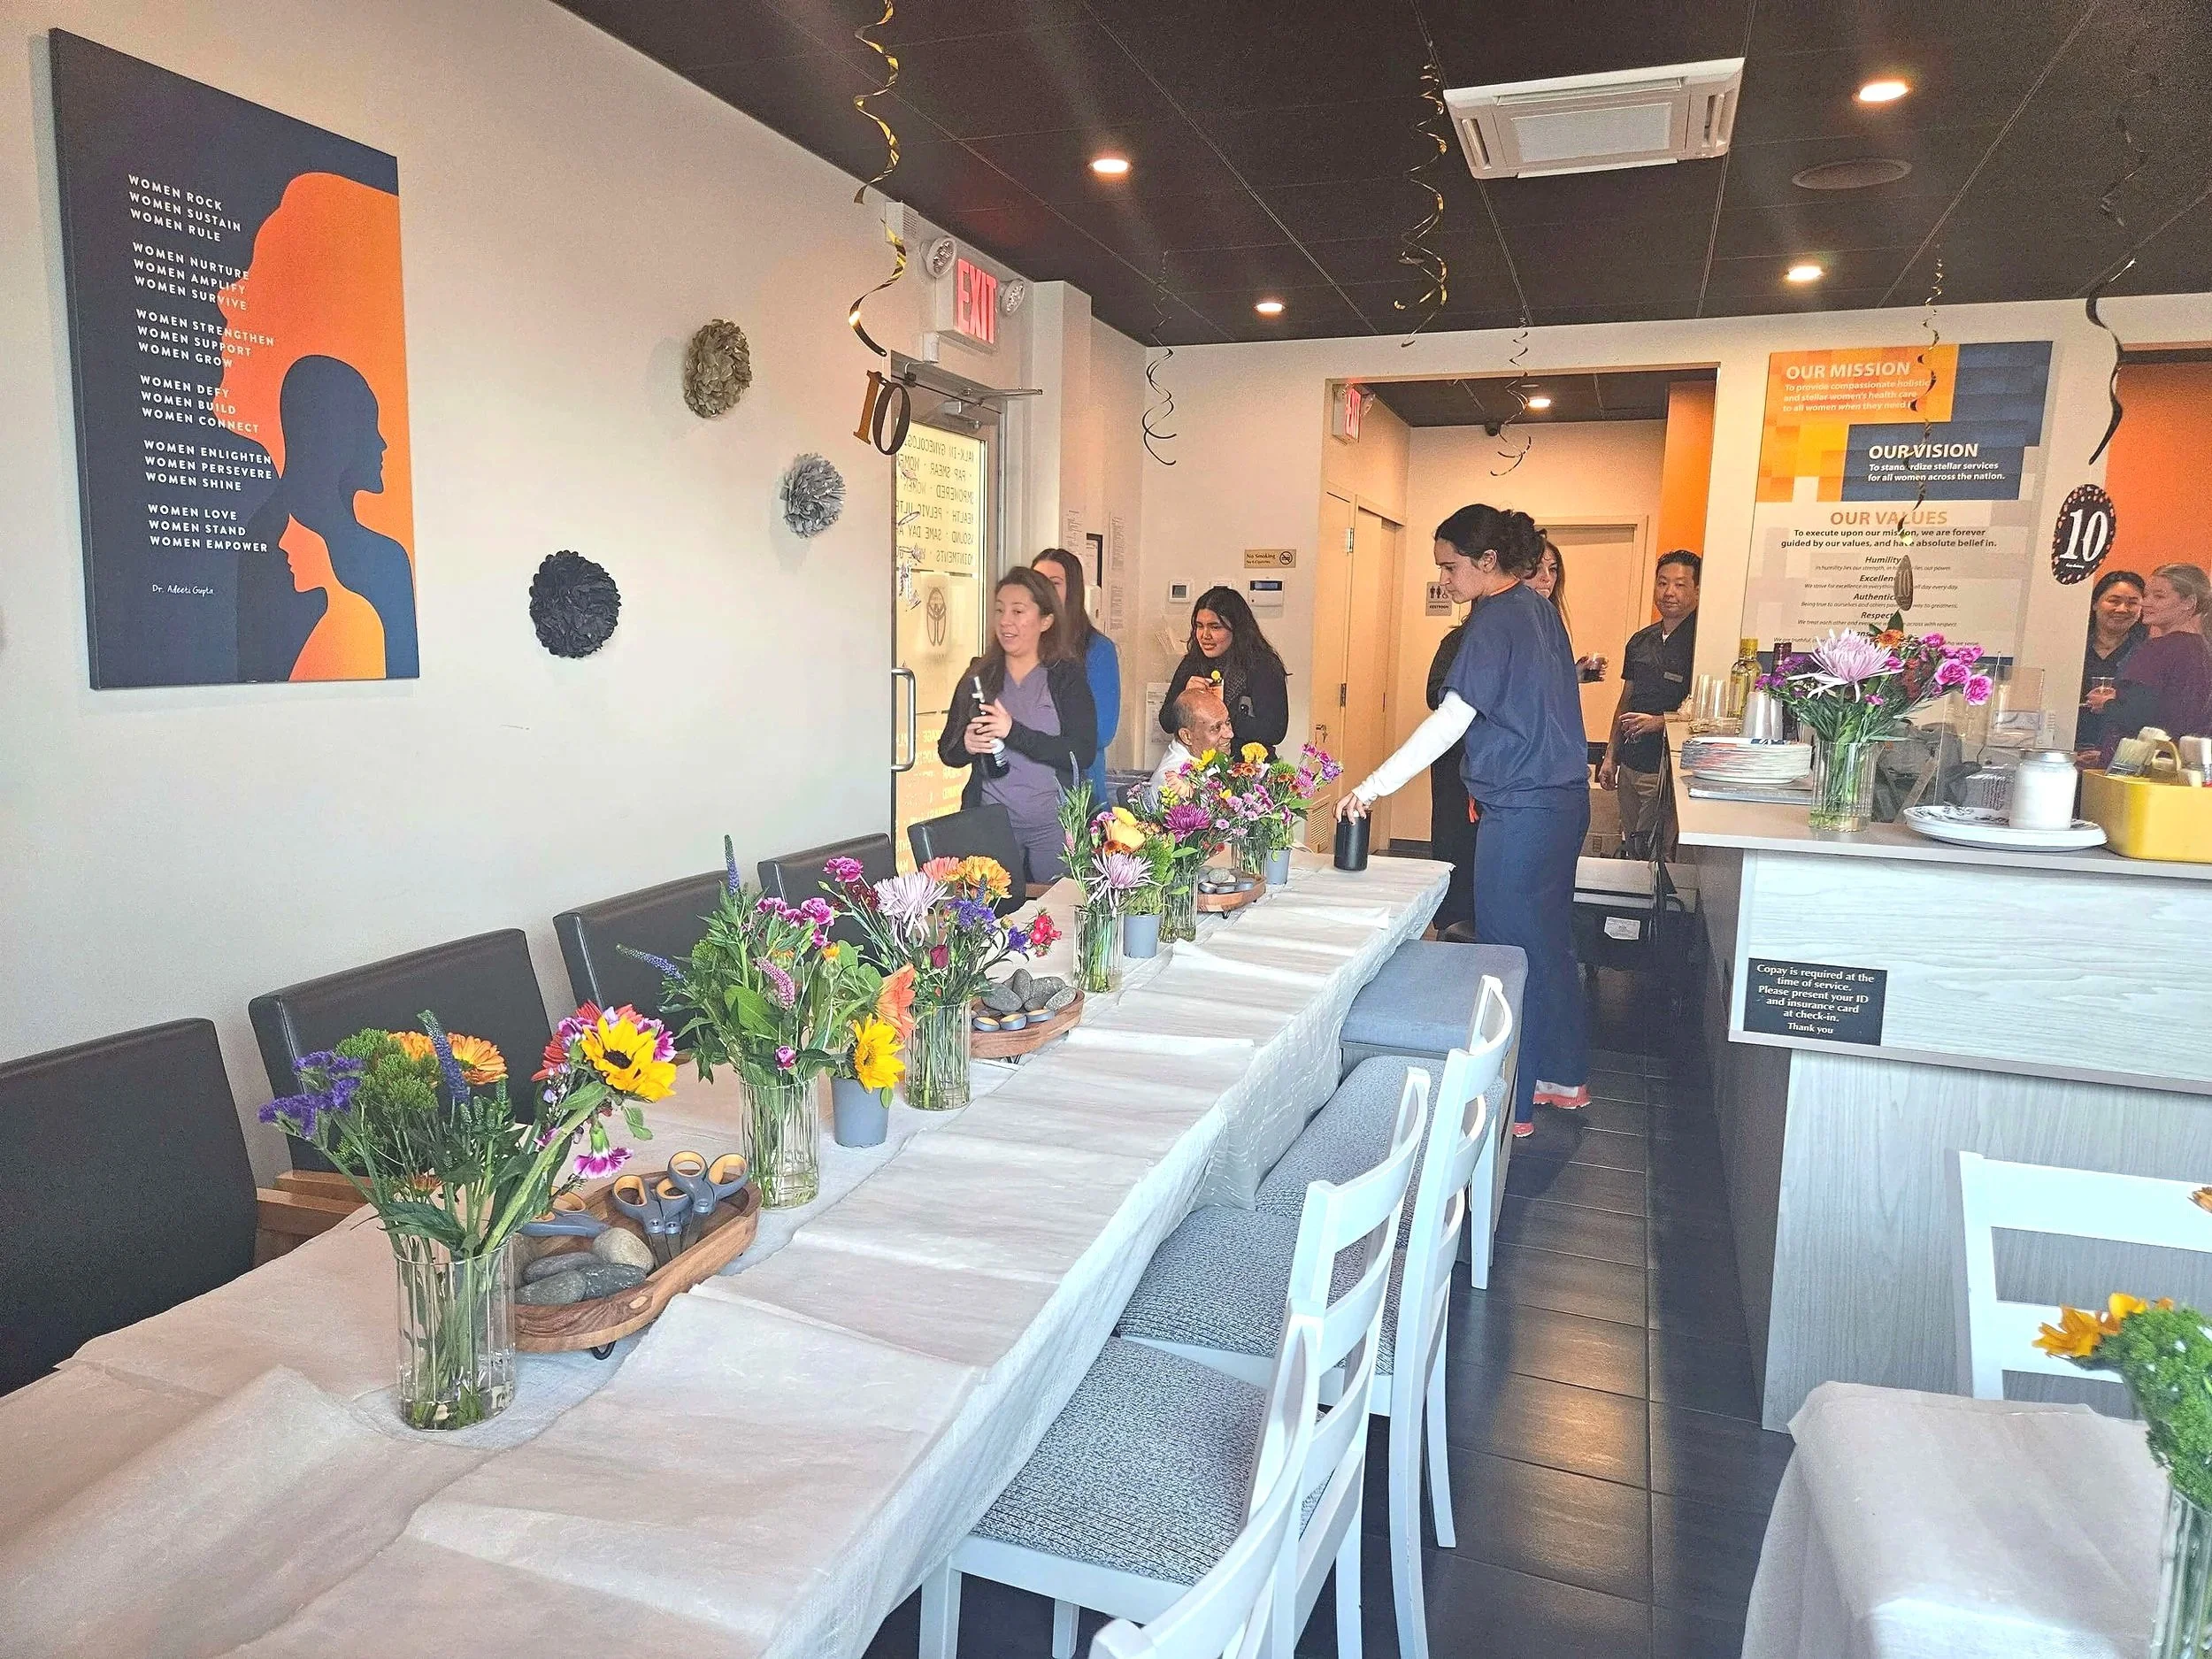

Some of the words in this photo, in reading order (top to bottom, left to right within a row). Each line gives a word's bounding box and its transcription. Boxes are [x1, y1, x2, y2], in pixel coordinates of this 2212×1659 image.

[128, 173, 180, 199] WOMEN
[187, 192, 222, 211] ROCK
[129, 191, 181, 215] WOMEN
[187, 209, 241, 232] SUSTAIN
[130, 208, 182, 232] WOMEN
[188, 224, 221, 242] RULE
[133, 242, 184, 264] WOMEN
[190, 257, 250, 280] NURTURE
[134, 258, 185, 280] WOMEN
[191, 273, 246, 295] AMPLIFY
[134, 275, 186, 296] WOMEN
[191, 289, 247, 311] SURVIVE
[957, 258, 996, 344] EXIT
[136, 309, 188, 328] WOMEN
[193, 321, 274, 346] STRENGTHEN
[137, 326, 188, 344] WOMEN
[194, 337, 251, 357] SUPPORT
[138, 342, 189, 361] WOMEN
[196, 353, 233, 369] GROW
[1786, 365, 1825, 380] OUR
[1830, 362, 1911, 378] MISSION
[140, 374, 191, 392] WOMEN
[197, 384, 229, 398] DEFY
[1796, 382, 1829, 393] provide
[1831, 380, 1896, 392] compassionate
[141, 391, 192, 408] WOMEN
[198, 400, 236, 415] BUILD
[1801, 393, 1828, 402] stellar
[1869, 390, 1897, 399] health
[854, 370, 910, 455] 10
[1863, 402, 1883, 411] they
[142, 407, 193, 424] WOMEN
[198, 416, 259, 433] CONNECT
[144, 440, 195, 455] WOMEN
[201, 447, 272, 465] ENLIGHTEN
[1869, 444, 1909, 459] OUR
[1912, 443, 1979, 459] VISION
[145, 456, 196, 471] WOMEN
[202, 463, 273, 480] PERSEVERE
[1933, 462, 1962, 471] stellar
[1963, 461, 2000, 470] services
[146, 472, 196, 487] WOMEN
[203, 479, 242, 491] SHINE
[1868, 473, 1881, 482] for
[1973, 472, 2006, 480] nation.
[148, 503, 199, 518] WOMEN
[204, 509, 237, 520] LOVE
[1831, 511, 1870, 526] OUR
[149, 520, 199, 533] WOMEN
[205, 525, 246, 536] STAND
[2059, 509, 2108, 562] 10
[150, 536, 200, 549] WOMEN
[206, 540, 268, 552] EMPOWER
[1781, 540, 1811, 549] guided
[1864, 556, 1901, 565] Humility
[152, 584, 165, 593] Dr.
[1861, 611, 1893, 620] Respect
[1756, 964, 1788, 976] Copay
[1801, 968, 1843, 980] required
[1845, 971, 1855, 981] at
[1858, 973, 1875, 983] the
[1777, 977, 1799, 987] time
[1801, 979, 1812, 987] of
[1814, 981, 1852, 992] service.
[1758, 985, 1789, 996] Please
[1792, 990, 1828, 1000] present
[1831, 993, 1854, 1002] your
[1856, 995, 1869, 1003] ID
[1766, 997, 1785, 1006] and
[1787, 1000, 1834, 1010] insurance
[1837, 1003, 1859, 1013] card
[1795, 1010, 1839, 1023] check-in.
[1787, 1022, 1815, 1033] Thank
[1816, 1025, 1833, 1035] you
